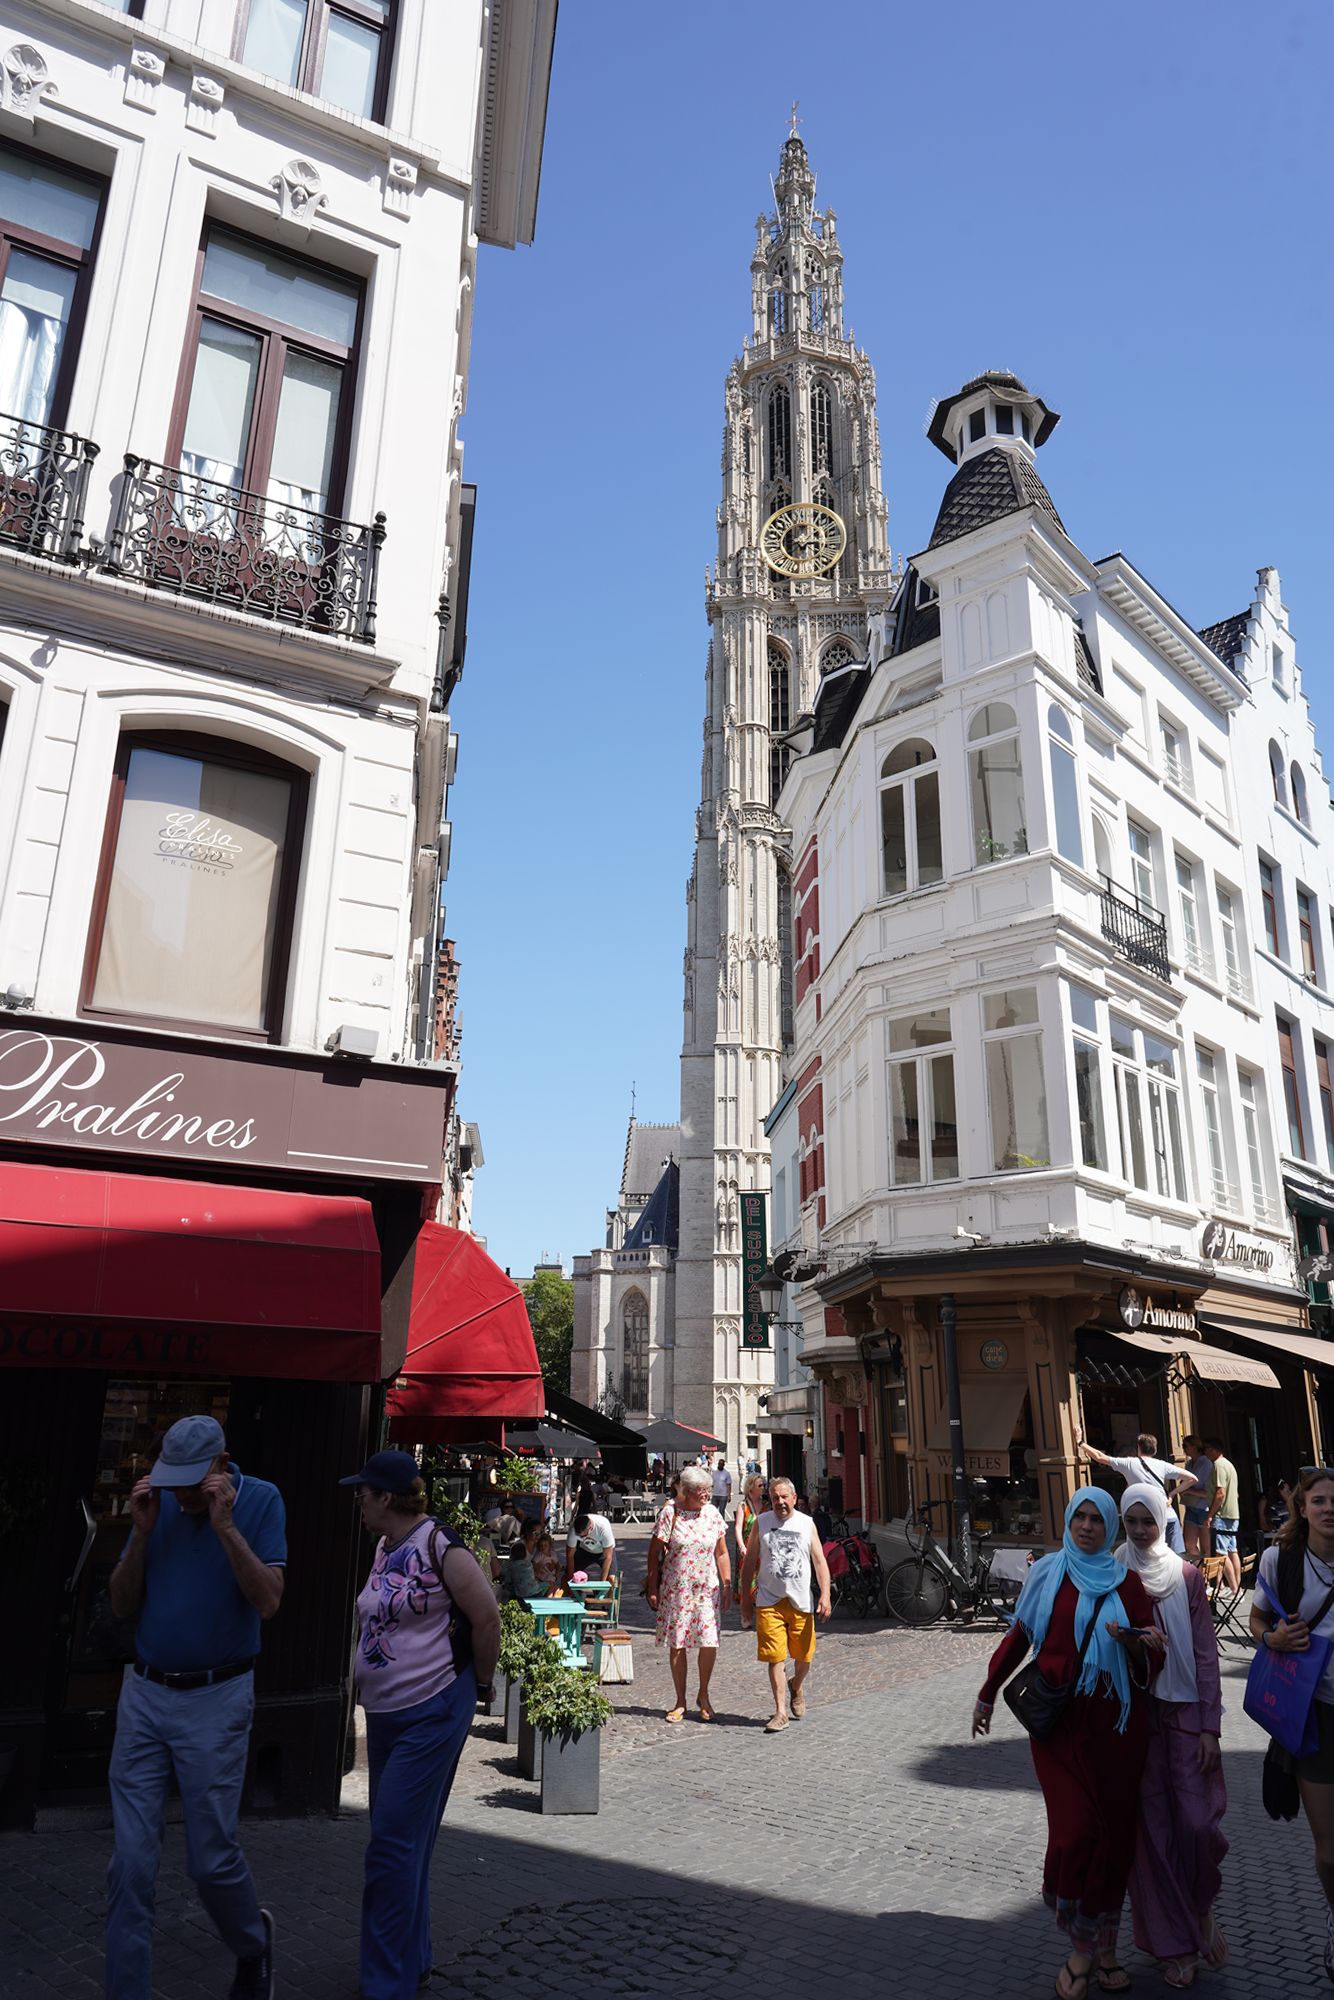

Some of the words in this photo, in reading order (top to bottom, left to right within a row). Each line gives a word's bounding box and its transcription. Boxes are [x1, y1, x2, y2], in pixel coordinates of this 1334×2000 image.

[161, 813, 243, 852] Elisa
[0, 1030, 257, 1149] Pralines
[745, 1198, 761, 1226] DEL
[746, 1230, 762, 1260] SUD
[1225, 1231, 1274, 1269] Amorino
[747, 1263, 764, 1344] CLASSICO
[1142, 1295, 1196, 1332] Amorino
[938, 1456, 1001, 1470] WFLES
